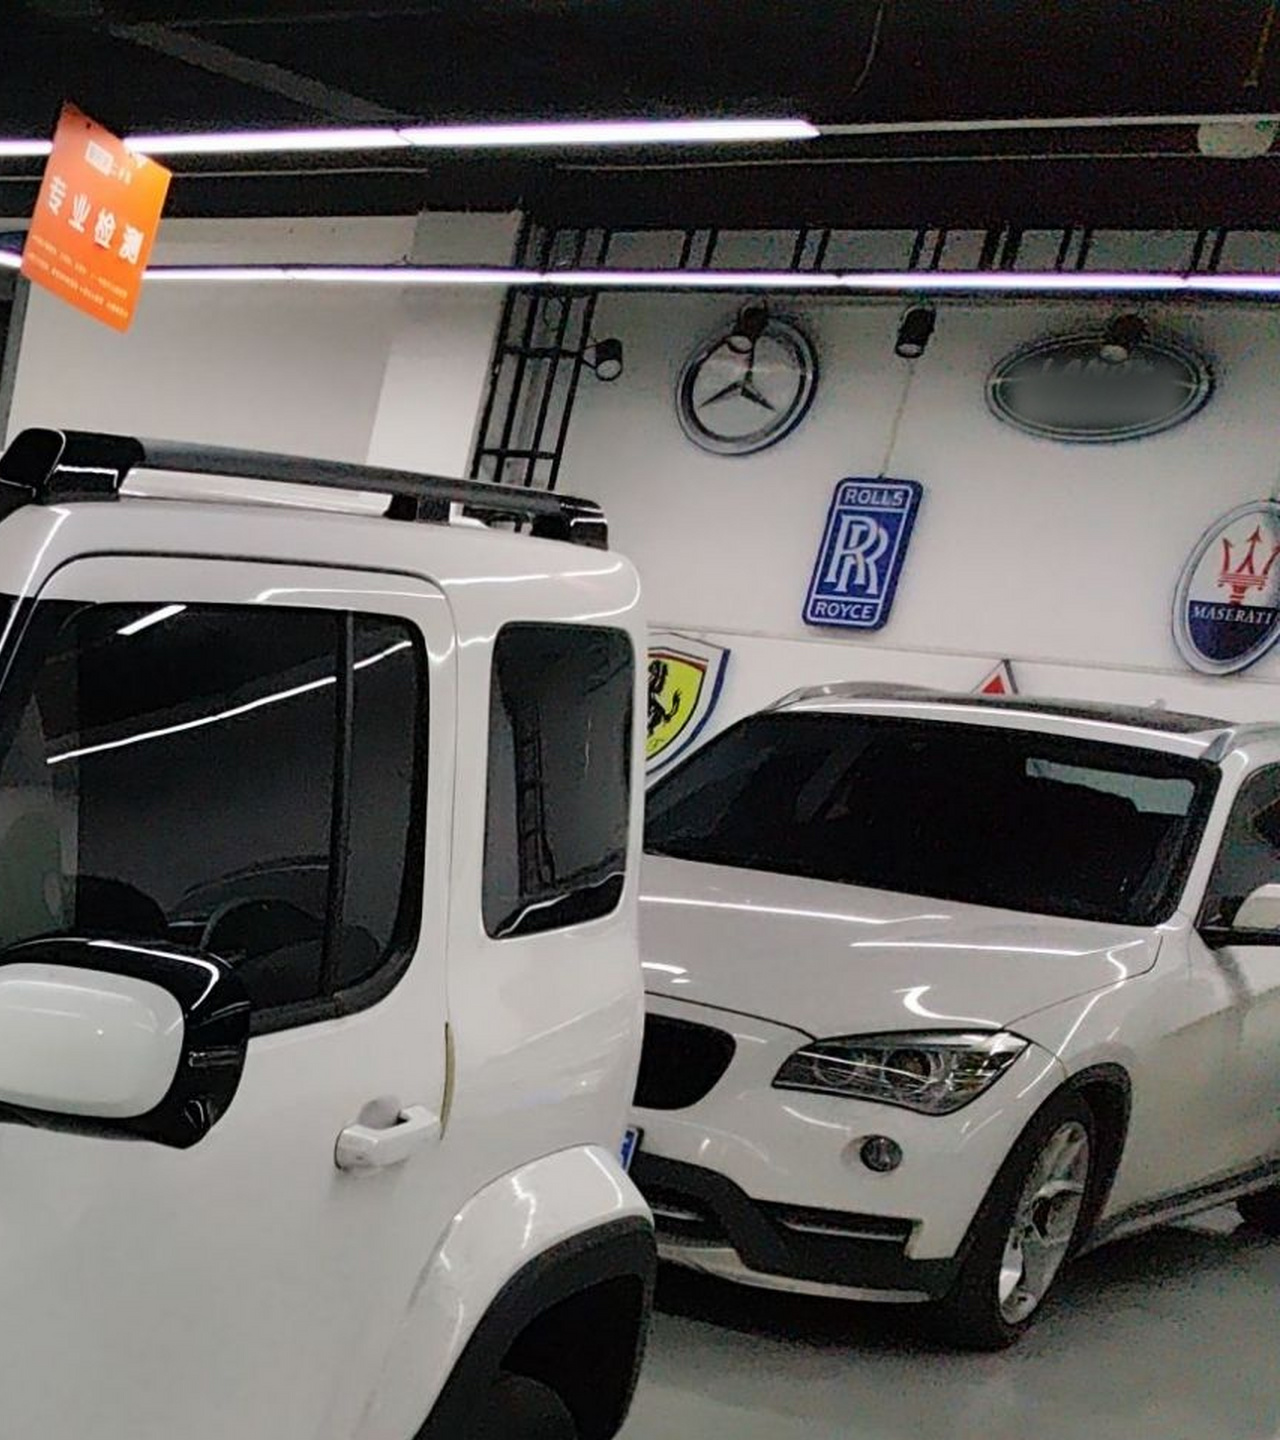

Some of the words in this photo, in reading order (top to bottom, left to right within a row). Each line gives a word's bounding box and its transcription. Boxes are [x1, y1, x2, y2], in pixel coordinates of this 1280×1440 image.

[844, 487, 905, 507] ROLLS
[814, 601, 874, 619] ROYCE
[1192, 605, 1274, 626] MASERATI
